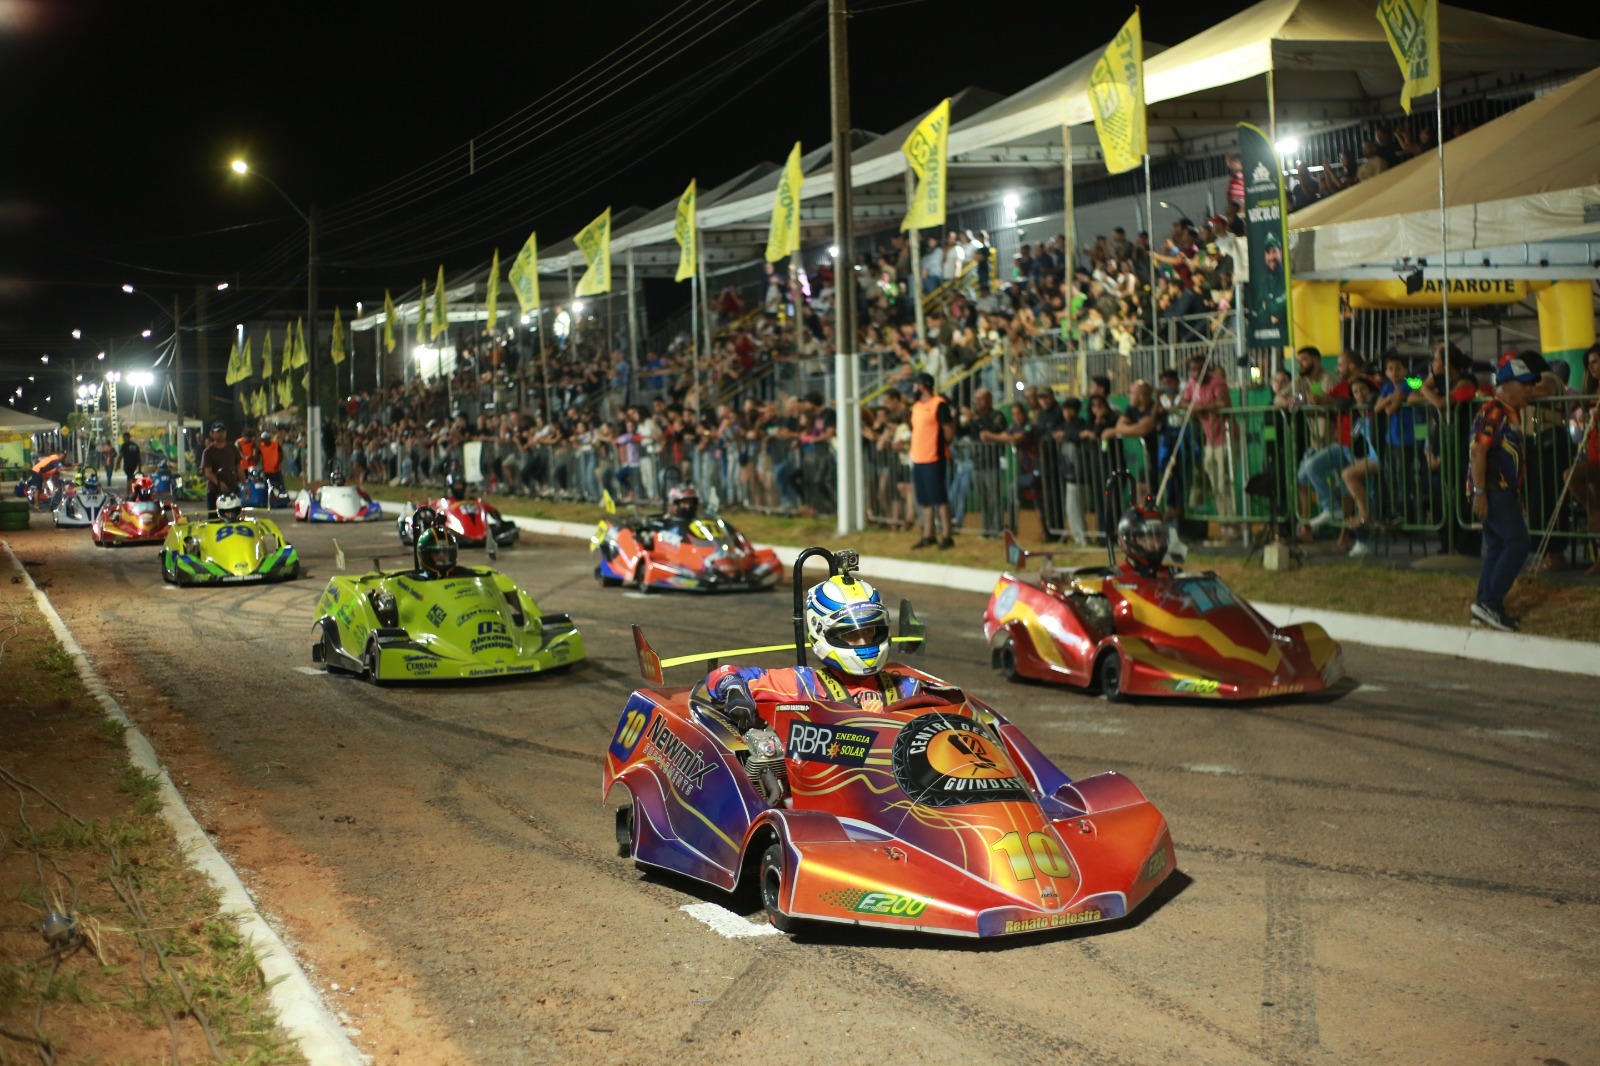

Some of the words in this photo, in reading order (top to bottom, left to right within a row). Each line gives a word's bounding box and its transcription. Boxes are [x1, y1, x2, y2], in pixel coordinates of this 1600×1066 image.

[1417, 279, 1515, 293] AMAROTE
[216, 525, 254, 542] 89
[478, 621, 506, 635] 03
[617, 709, 646, 749] 10
[789, 724, 832, 756] RBR
[835, 732, 870, 744] ENERGIA
[840, 745, 866, 758] SOLAR
[642, 743, 694, 796] SUPPLEMENTS
[944, 777, 1021, 791] GUINDAS
[991, 831, 1070, 881] 10
[1005, 916, 1048, 933] Renato
[1051, 909, 1100, 927] Balestra
